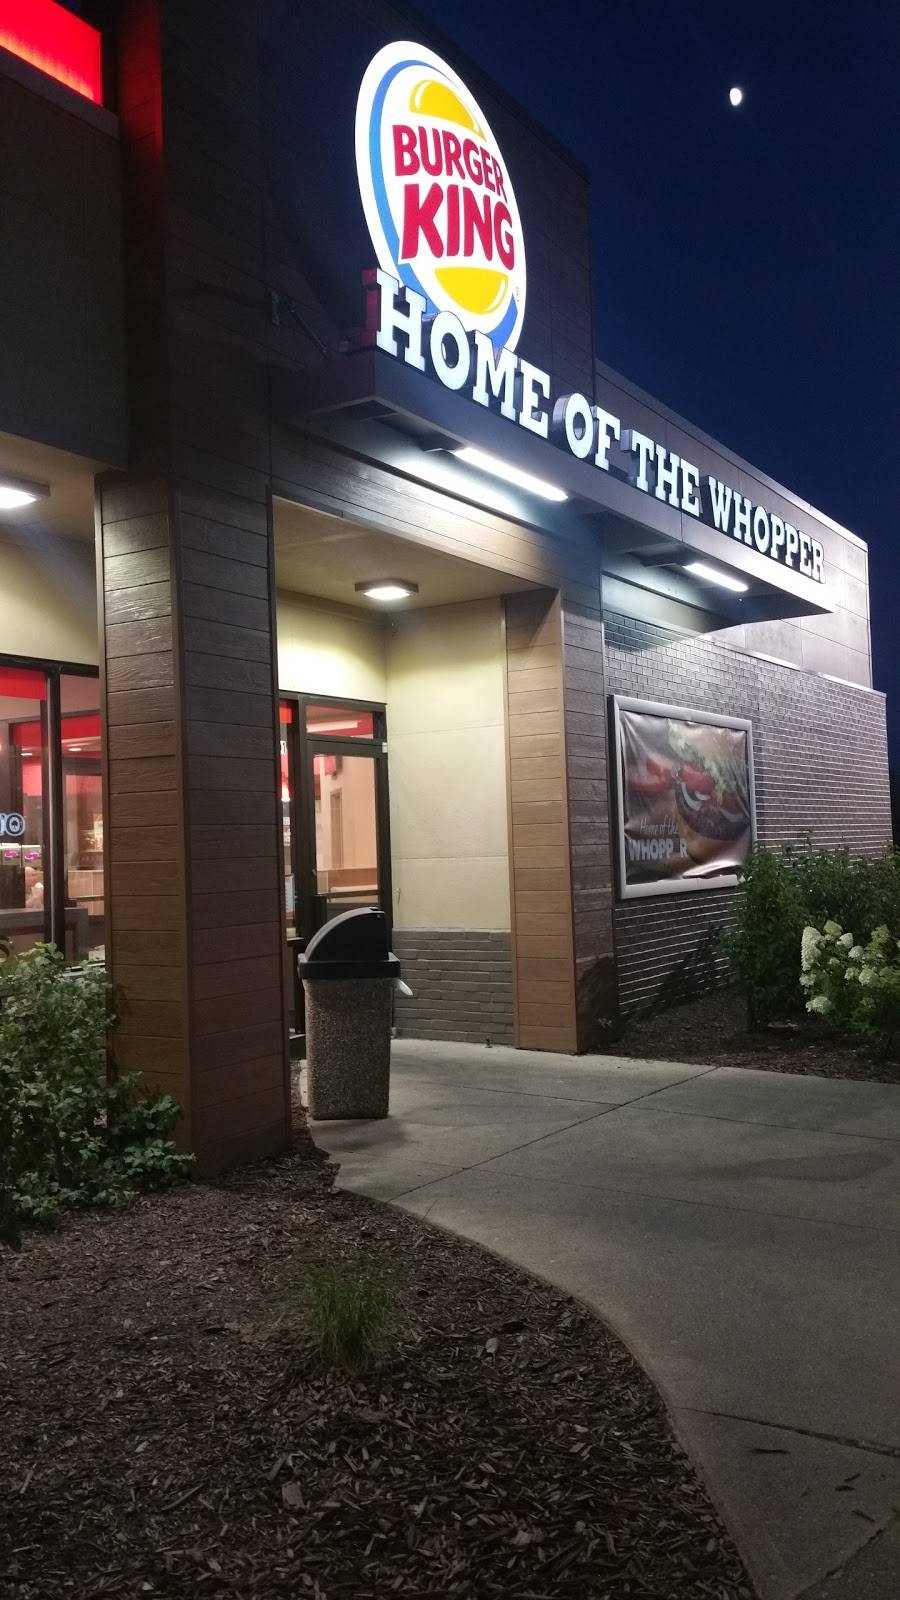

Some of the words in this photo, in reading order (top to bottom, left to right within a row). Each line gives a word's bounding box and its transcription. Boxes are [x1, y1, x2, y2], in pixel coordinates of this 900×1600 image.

[392, 124, 508, 204] BURGER
[401, 182, 515, 271] KING
[376, 267, 551, 439] HOME
[565, 392, 621, 472] OF
[631, 429, 700, 518] THE
[708, 475, 826, 585] WHOPPER
[628, 838, 688, 861] WHOPPR
